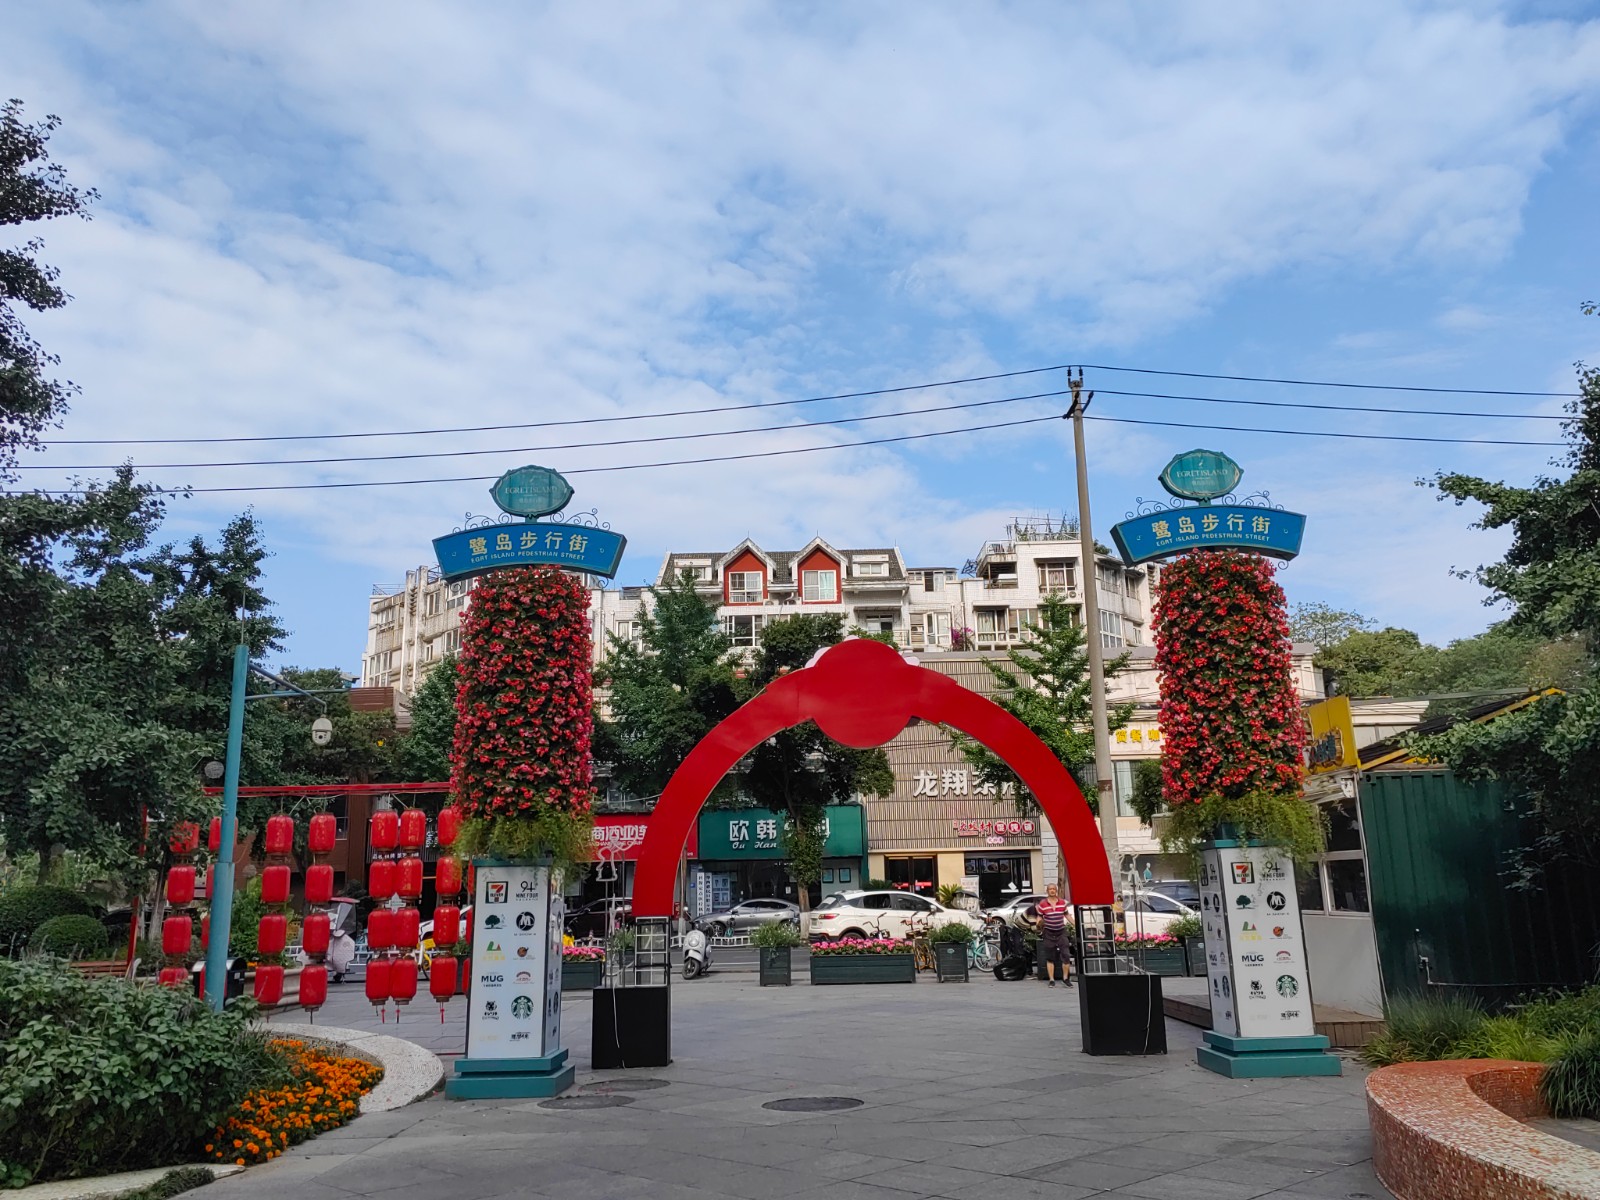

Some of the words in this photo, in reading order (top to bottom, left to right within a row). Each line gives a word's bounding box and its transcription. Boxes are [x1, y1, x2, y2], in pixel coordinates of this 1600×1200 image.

[1151, 513, 1271, 540] 鹭岛步行街
[1175, 534, 1200, 542] ISLAND
[1245, 533, 1271, 542] STREET
[469, 530, 588, 556] 鹭岛步行街
[491, 551, 515, 560] ISLAND
[560, 551, 585, 561] STREET
[1241, 954, 1265, 963] MUG
[481, 974, 504, 983] MUG
